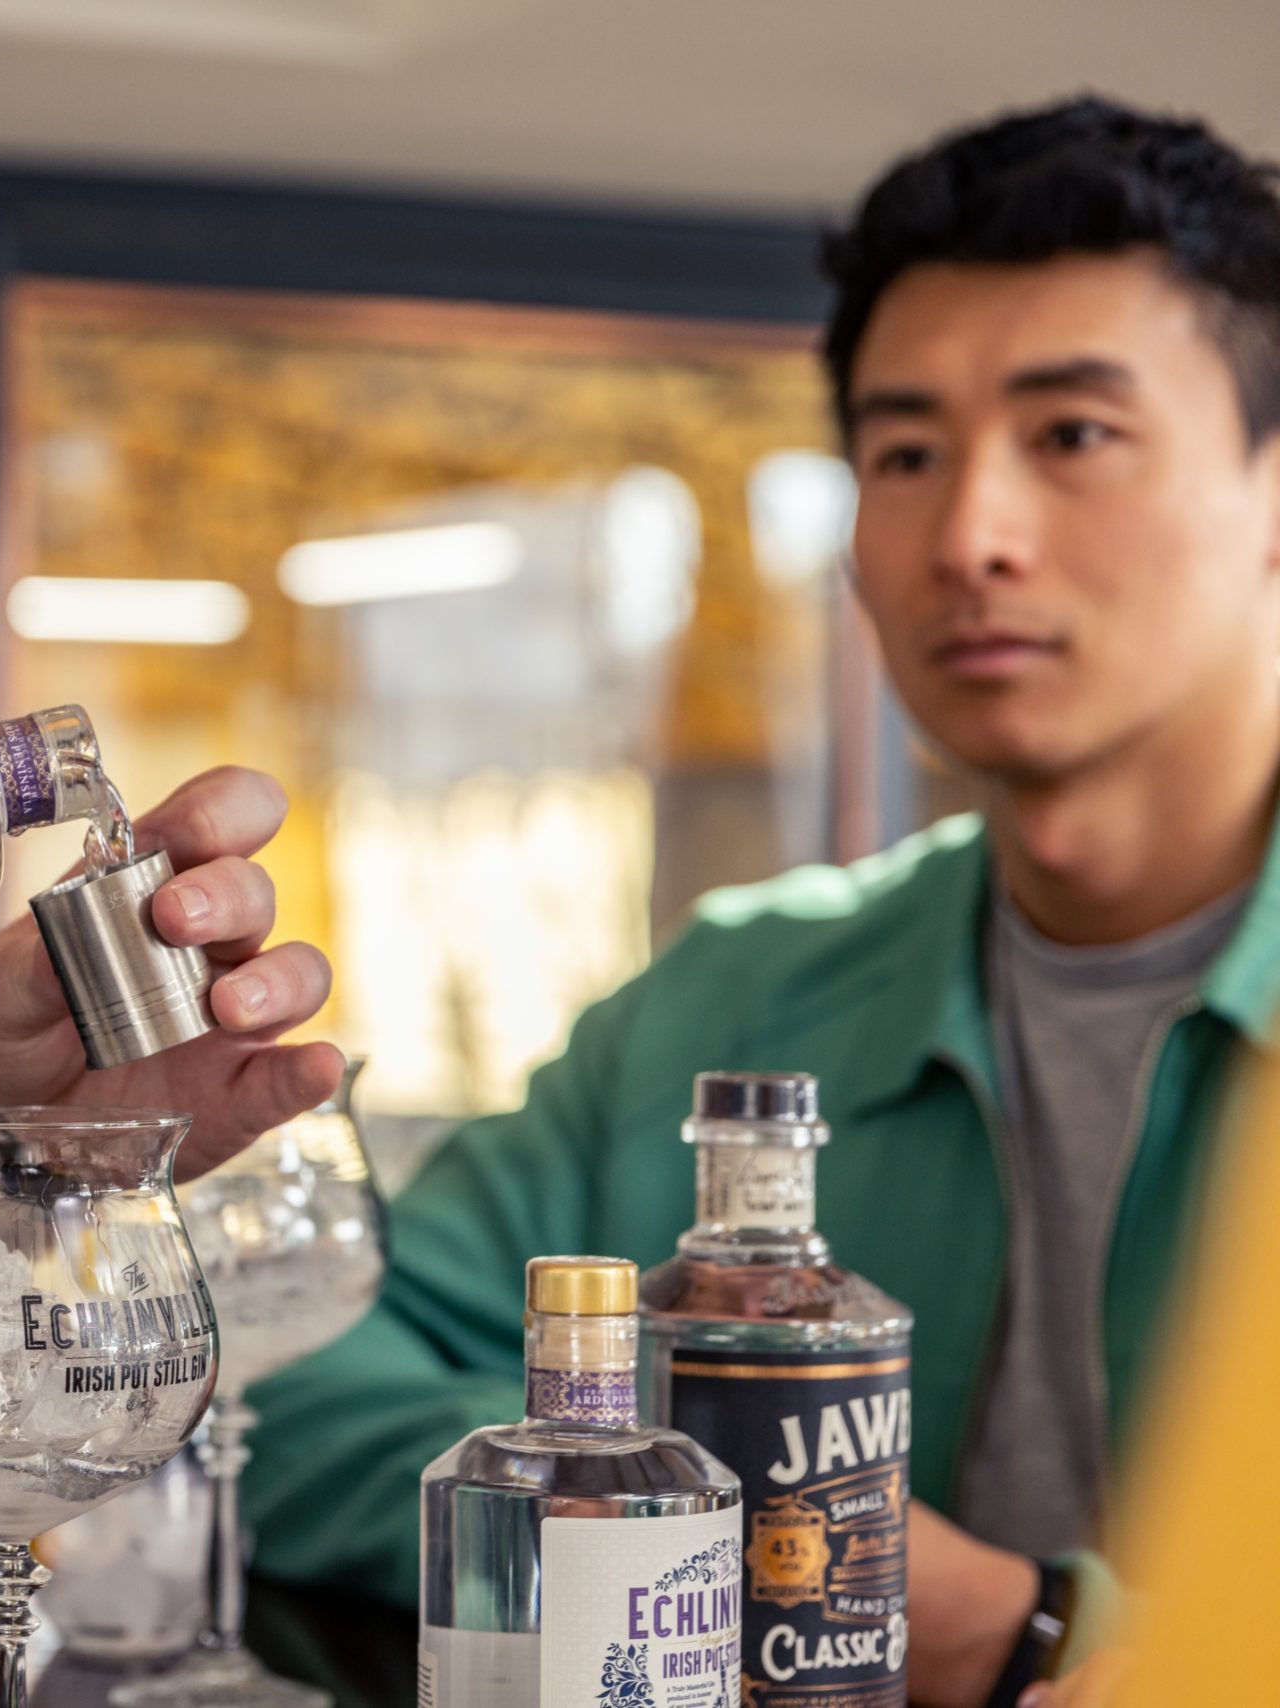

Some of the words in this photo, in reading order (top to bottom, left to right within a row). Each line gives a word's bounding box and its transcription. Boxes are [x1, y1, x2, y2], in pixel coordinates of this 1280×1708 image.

[11, 744, 33, 814] PENINSULA
[122, 1263, 149, 1293] The
[65, 1365, 115, 1393] IRISH
[120, 1361, 150, 1390] POT
[154, 1357, 188, 1387] STILL
[191, 1353, 208, 1381] GIN
[830, 1490, 885, 1521] SMALL
[663, 1650, 702, 1679] IRISH
[761, 1624, 884, 1681] CLASSIC
